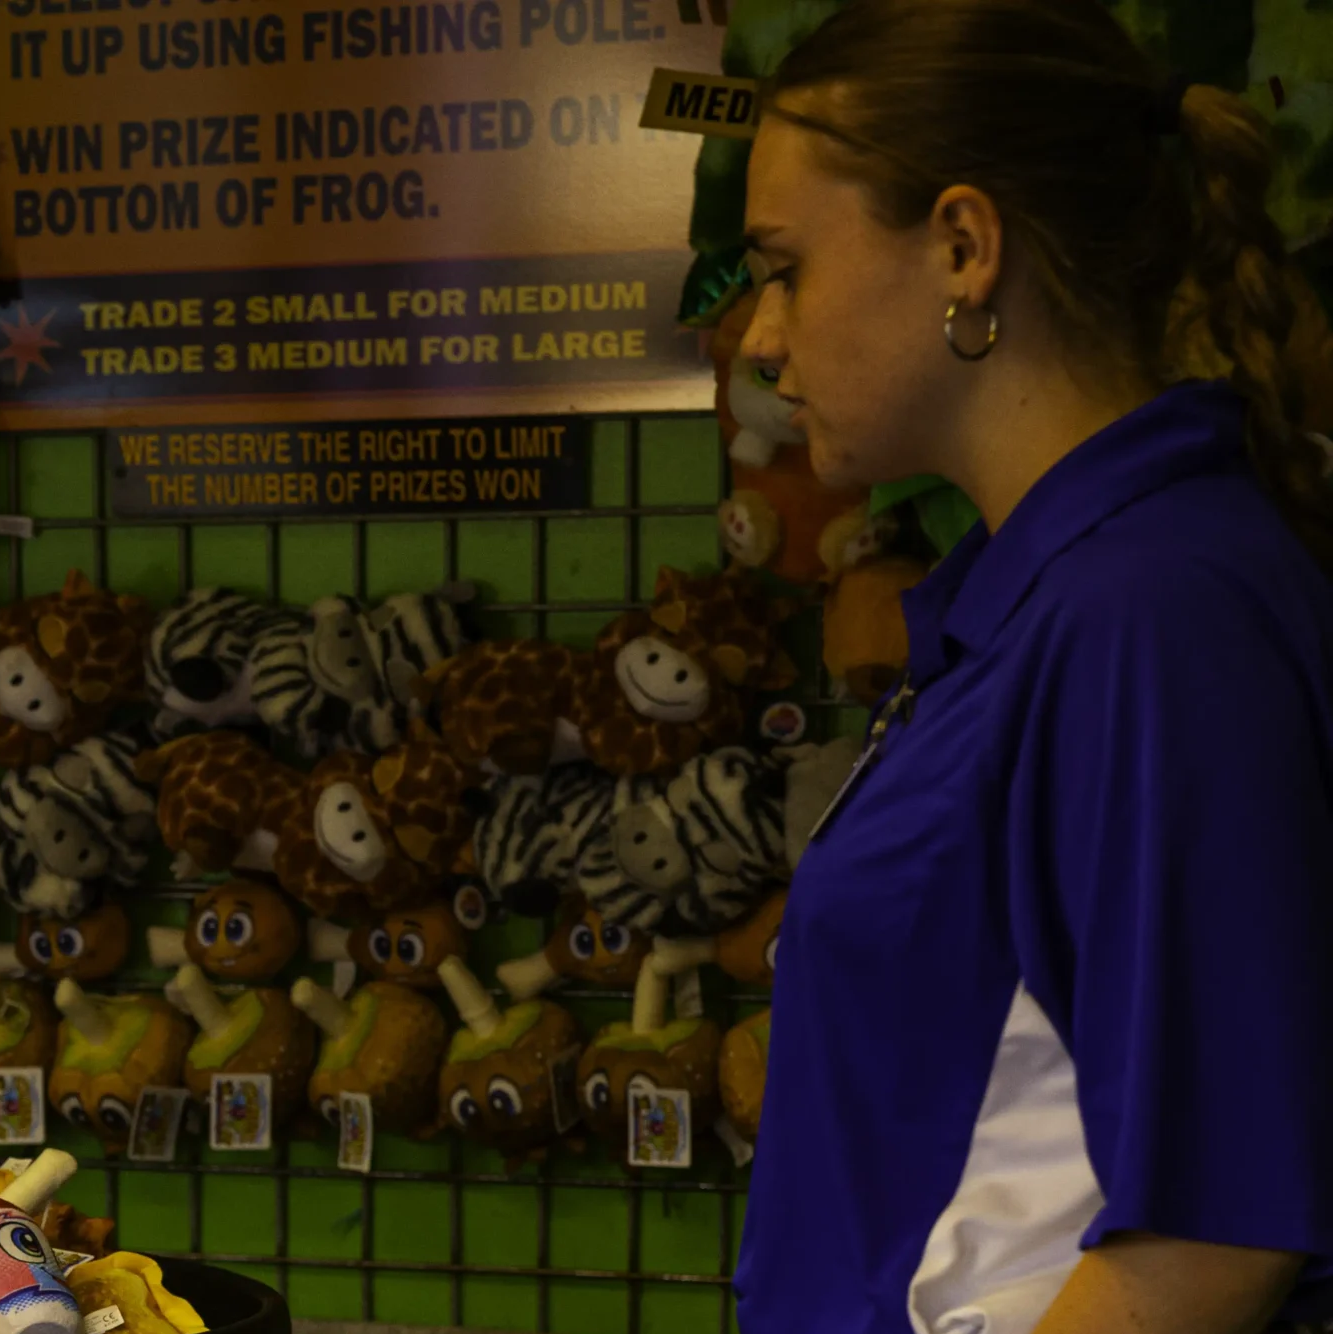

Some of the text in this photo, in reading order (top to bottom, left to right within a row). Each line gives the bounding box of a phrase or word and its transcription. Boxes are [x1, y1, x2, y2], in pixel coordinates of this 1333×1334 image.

[10, 0, 665, 80] IT UP USING FISHING POLE.
[665, 81, 753, 124] MED
[11, 123, 103, 175] WIN
[119, 114, 261, 170] PRIZE
[275, 100, 532, 163] INDICATED
[549, 94, 621, 147] ON
[14, 170, 440, 238] BOTTOM OF FROG.
[80, 280, 647, 331] TRADE 2 SMALL FOR MEDIUM
[81, 329, 647, 376] TRADE 3 MEDIUM FOR LARGE
[119, 425, 567, 466] WE RESERVE THE RIGHT TO LIMIT
[146, 467, 542, 506] THE NUMBER OF PRIZES WON
